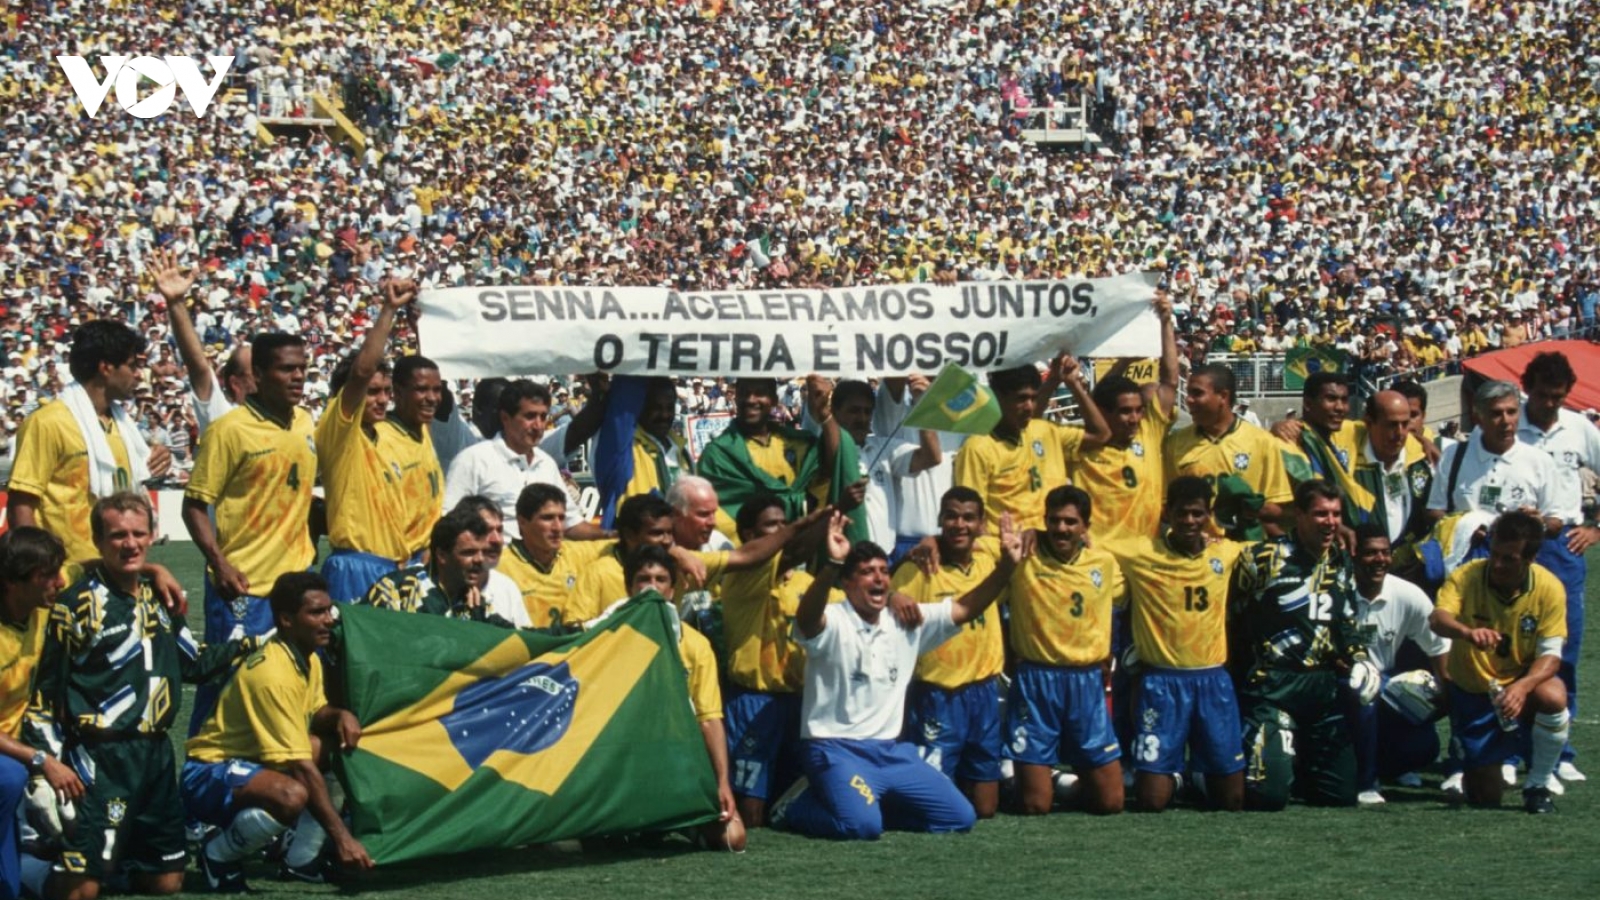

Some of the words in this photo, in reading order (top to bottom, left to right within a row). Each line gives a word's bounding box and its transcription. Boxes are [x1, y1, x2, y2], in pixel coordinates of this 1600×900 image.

[950, 283, 1098, 318] JUNTOS,
[594, 334, 624, 369] O
[639, 332, 795, 371] TETRA
[812, 325, 840, 371] É
[855, 331, 1007, 371] NOSSO!
[286, 462, 300, 491] 4
[1121, 465, 1137, 488] 9
[1069, 591, 1084, 617] 3
[1183, 585, 1209, 612] 13
[1308, 592, 1333, 620] 12
[1012, 726, 1028, 753] 3
[1136, 733, 1160, 762] 13
[734, 759, 762, 789] 17
[102, 828, 116, 860] 1
